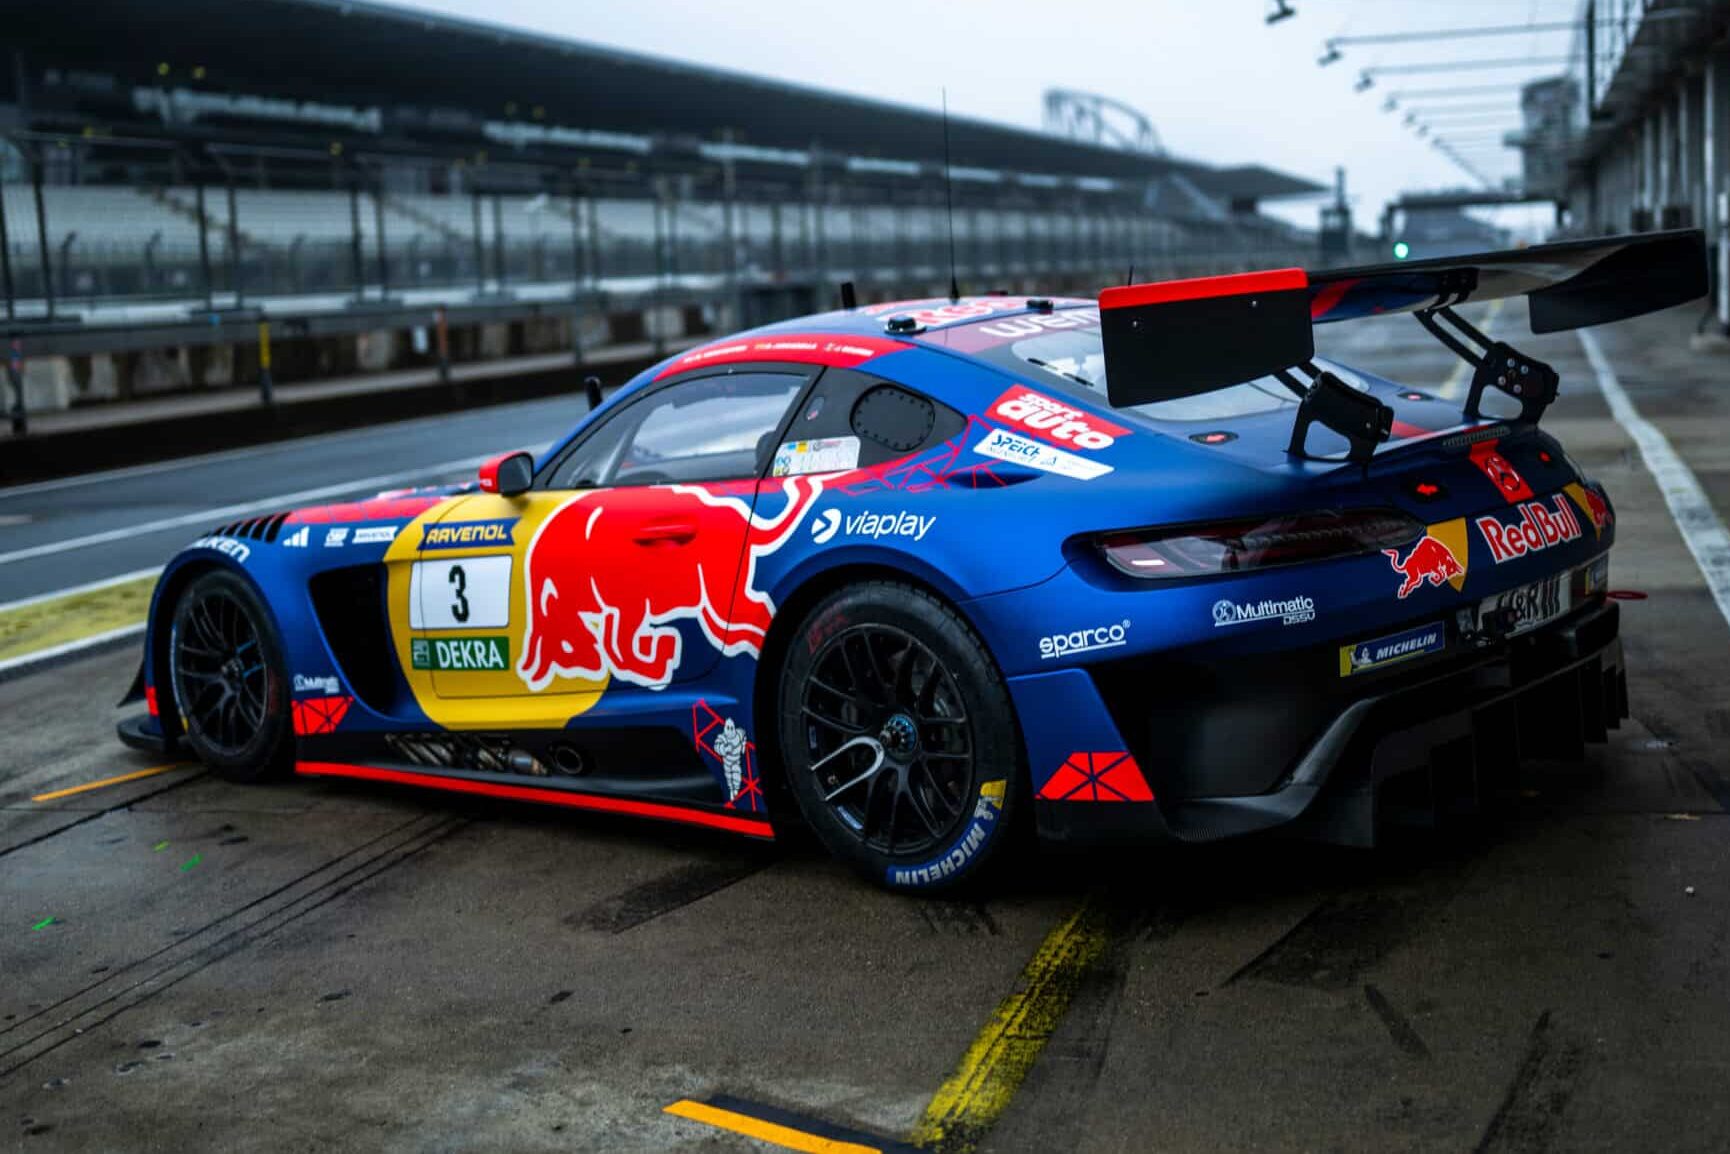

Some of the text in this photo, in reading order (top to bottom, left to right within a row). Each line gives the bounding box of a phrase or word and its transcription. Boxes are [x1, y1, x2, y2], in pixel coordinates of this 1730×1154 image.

[996, 399, 1115, 450] auto
[426, 524, 507, 545] RAVENOL
[845, 510, 937, 541] viaplay
[1475, 493, 1583, 565] Red Bull
[448, 564, 470, 624] 3
[1236, 594, 1314, 620] Multimatic
[434, 640, 505, 669] DEKRA
[1039, 624, 1125, 658] sparco
[1376, 632, 1437, 660] MICHELIN
[895, 823, 987, 885] MICHELIN
